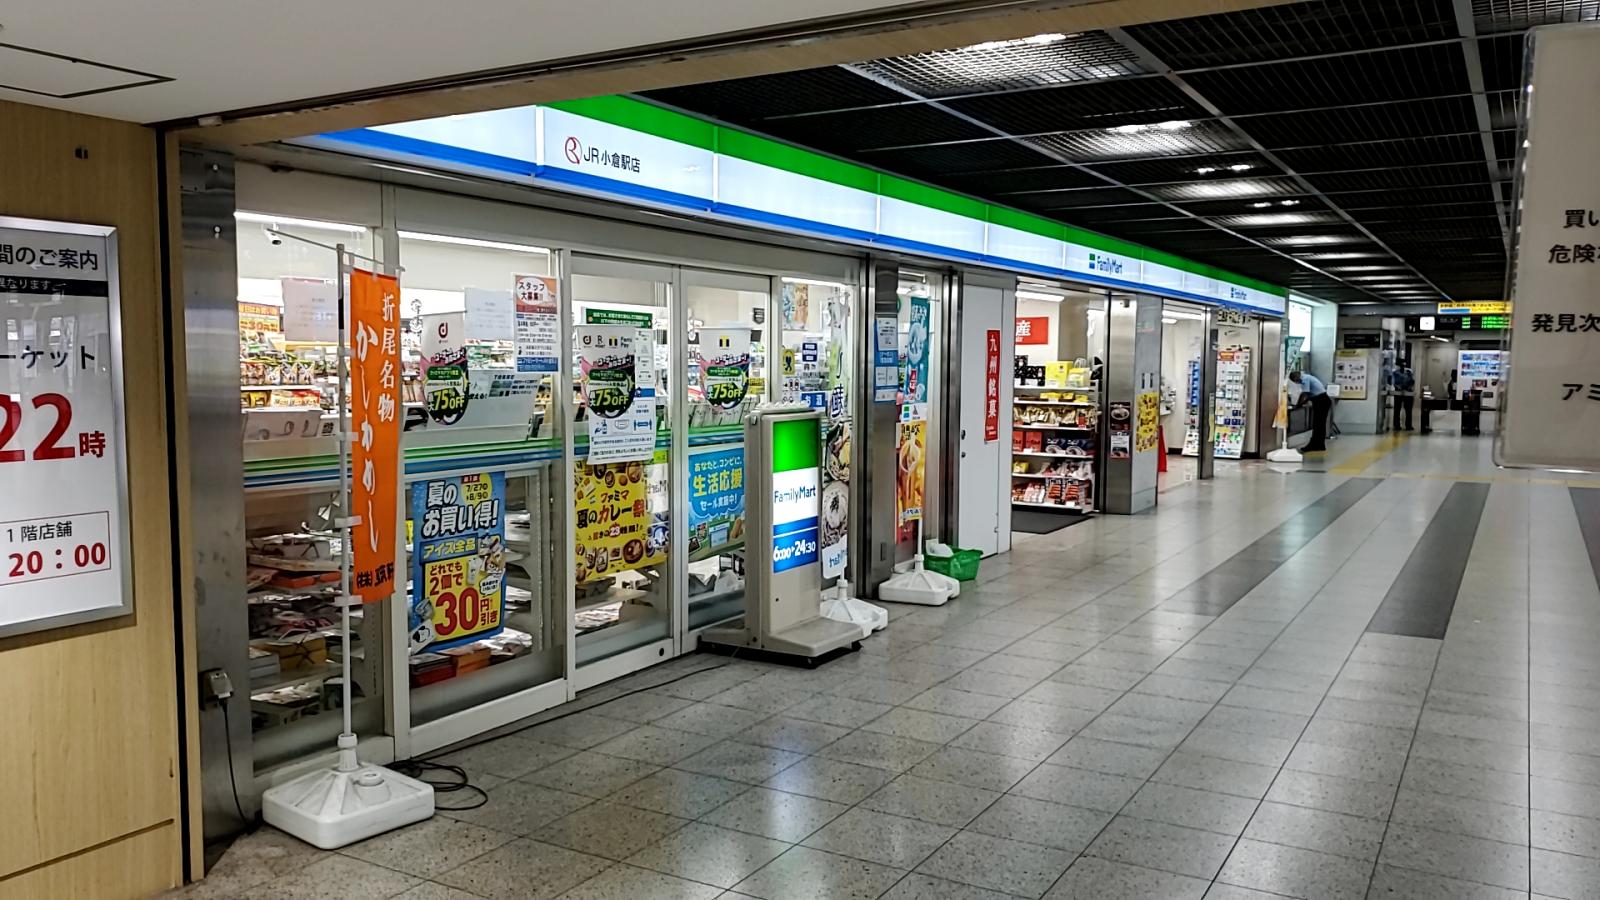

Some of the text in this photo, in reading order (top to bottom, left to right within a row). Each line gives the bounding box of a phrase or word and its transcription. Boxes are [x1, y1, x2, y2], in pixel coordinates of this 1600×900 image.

[0, 245, 98, 270] 間のご案内
[1548, 244, 1600, 263] 危険
[1531, 313, 1600, 333] 発見次
[377, 293, 396, 422] 折尾名物
[355, 320, 379, 553] かしわめし
[427, 482, 457, 508] 夏の
[693, 467, 742, 497] 生活応援
[774, 485, 816, 504] FamilyMart
[422, 499, 500, 538] お買い得!
[423, 538, 476, 559] アイス全品
[434, 586, 479, 636] 30
